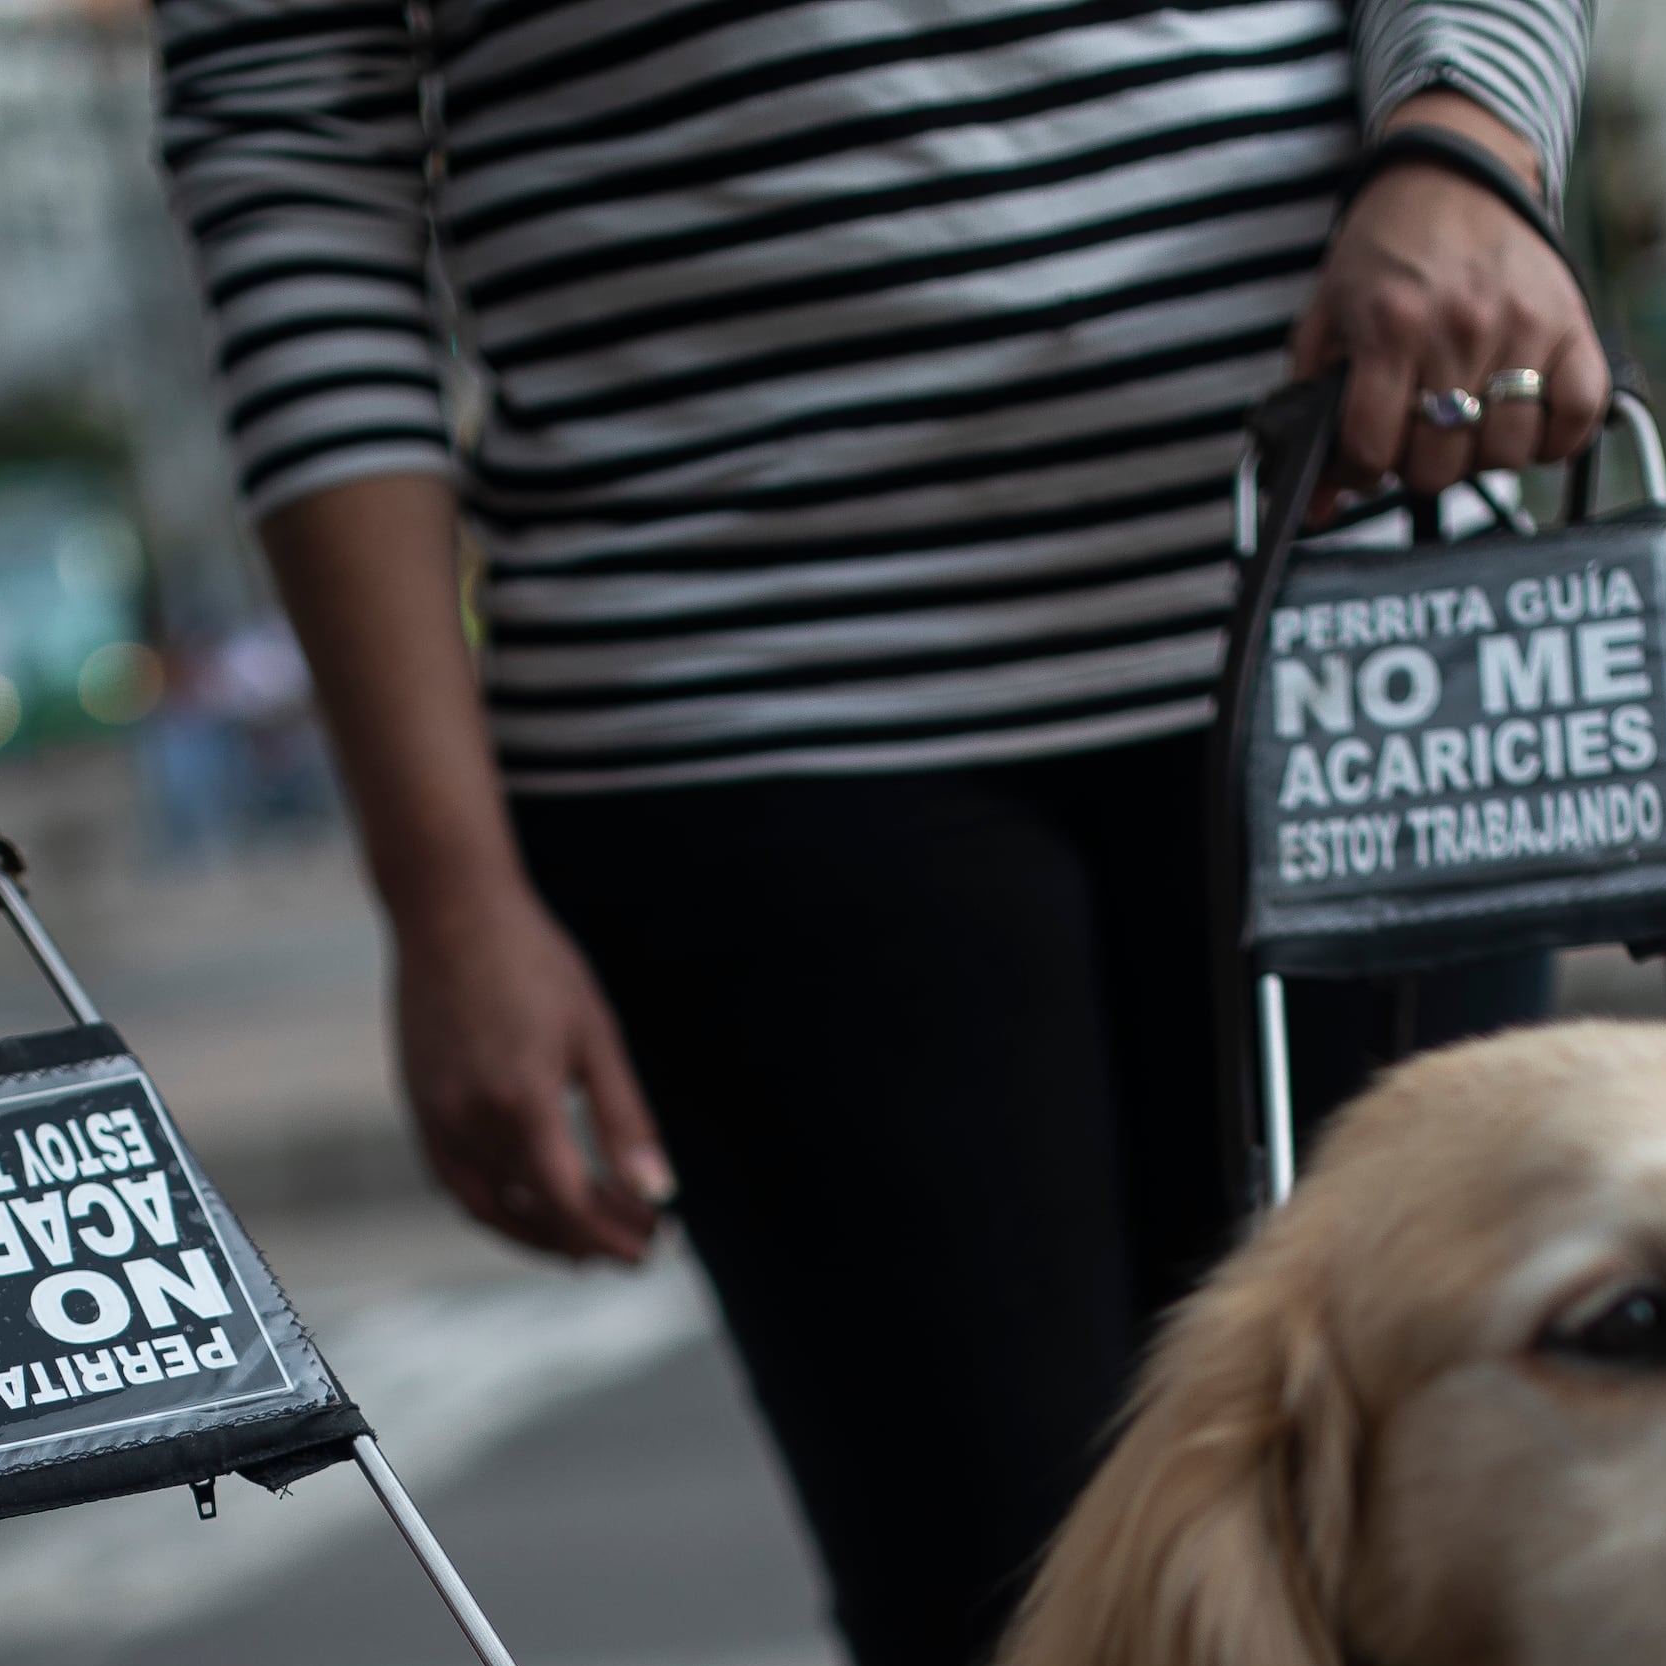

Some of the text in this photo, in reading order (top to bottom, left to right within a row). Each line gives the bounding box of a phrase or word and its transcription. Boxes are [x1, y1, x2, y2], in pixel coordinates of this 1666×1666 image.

[1271, 560, 1643, 652] PERRITA GUÍA
[1273, 618, 1653, 738] NO ME
[1278, 704, 1657, 810] ACARICIES
[1279, 781, 1662, 883] ESTOY TRABAJANDO
[15, 1108, 157, 1187] ESTOY
[30, 1248, 233, 1344] NO
